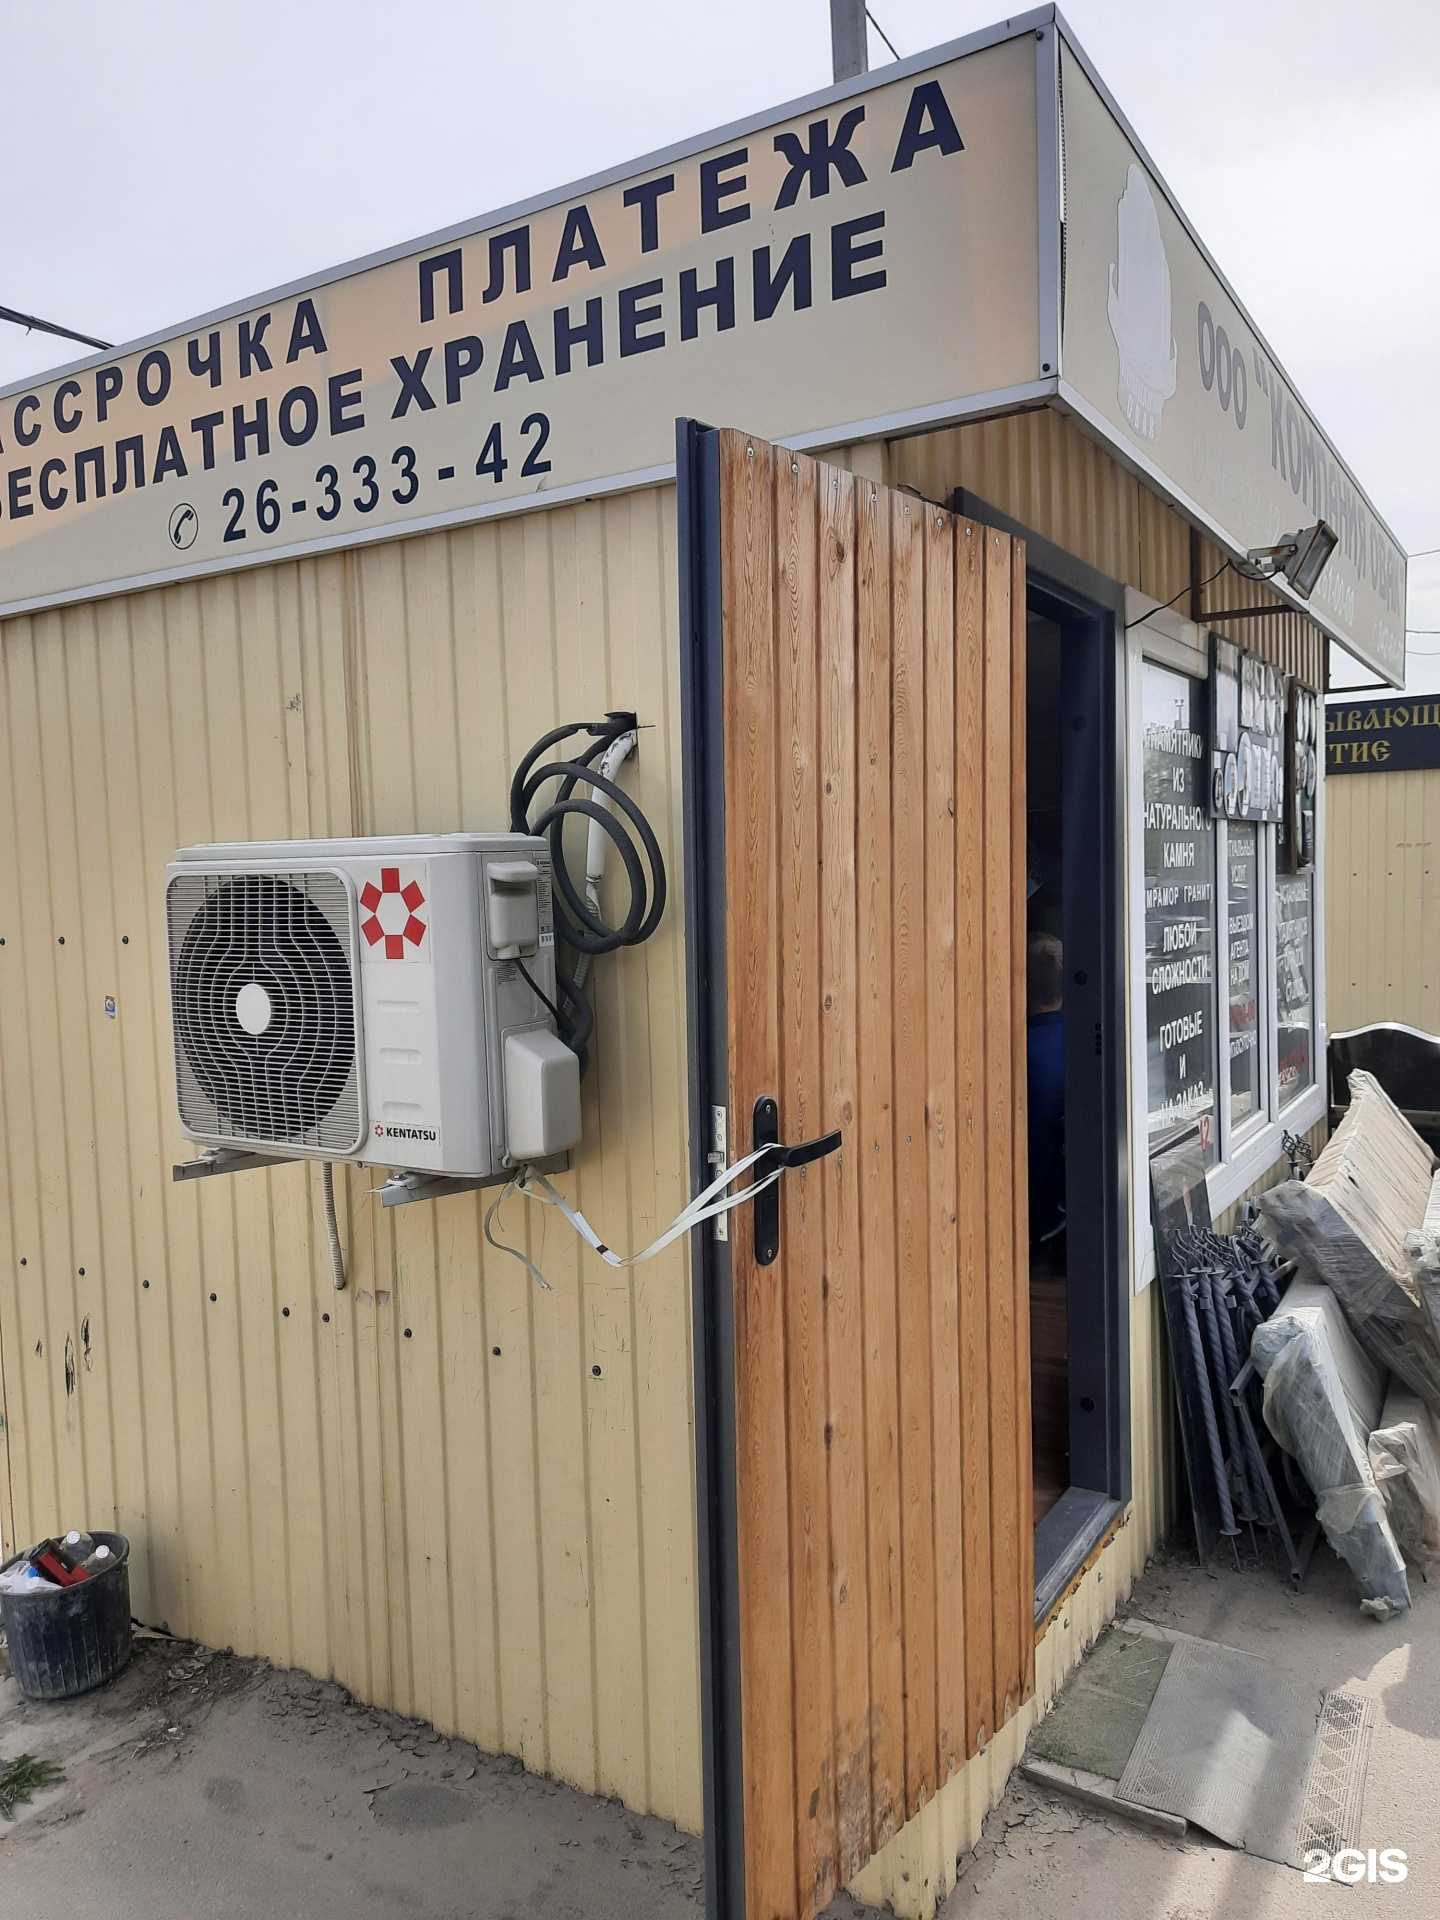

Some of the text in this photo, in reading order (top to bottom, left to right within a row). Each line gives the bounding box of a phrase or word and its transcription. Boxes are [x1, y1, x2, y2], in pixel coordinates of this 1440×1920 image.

[0, 79, 965, 455] ССРОЧКА ПЛАТЕЖА
[0, 210, 887, 520] ЕСПЛАТНОЕ ХРАНЕНИЕ
[1198, 301, 1247, 431] ООО
[1172, 767, 1185, 793] ИЗ
[1163, 842, 1195, 868] КАМНЯ
[1152, 954, 1208, 995] СЛОЖНОСТИ
[1159, 1010, 1203, 1053] ГОТОВЫЕ
[1179, 1053, 1187, 1080] И
[386, 1127, 437, 1141] KENTATSU
